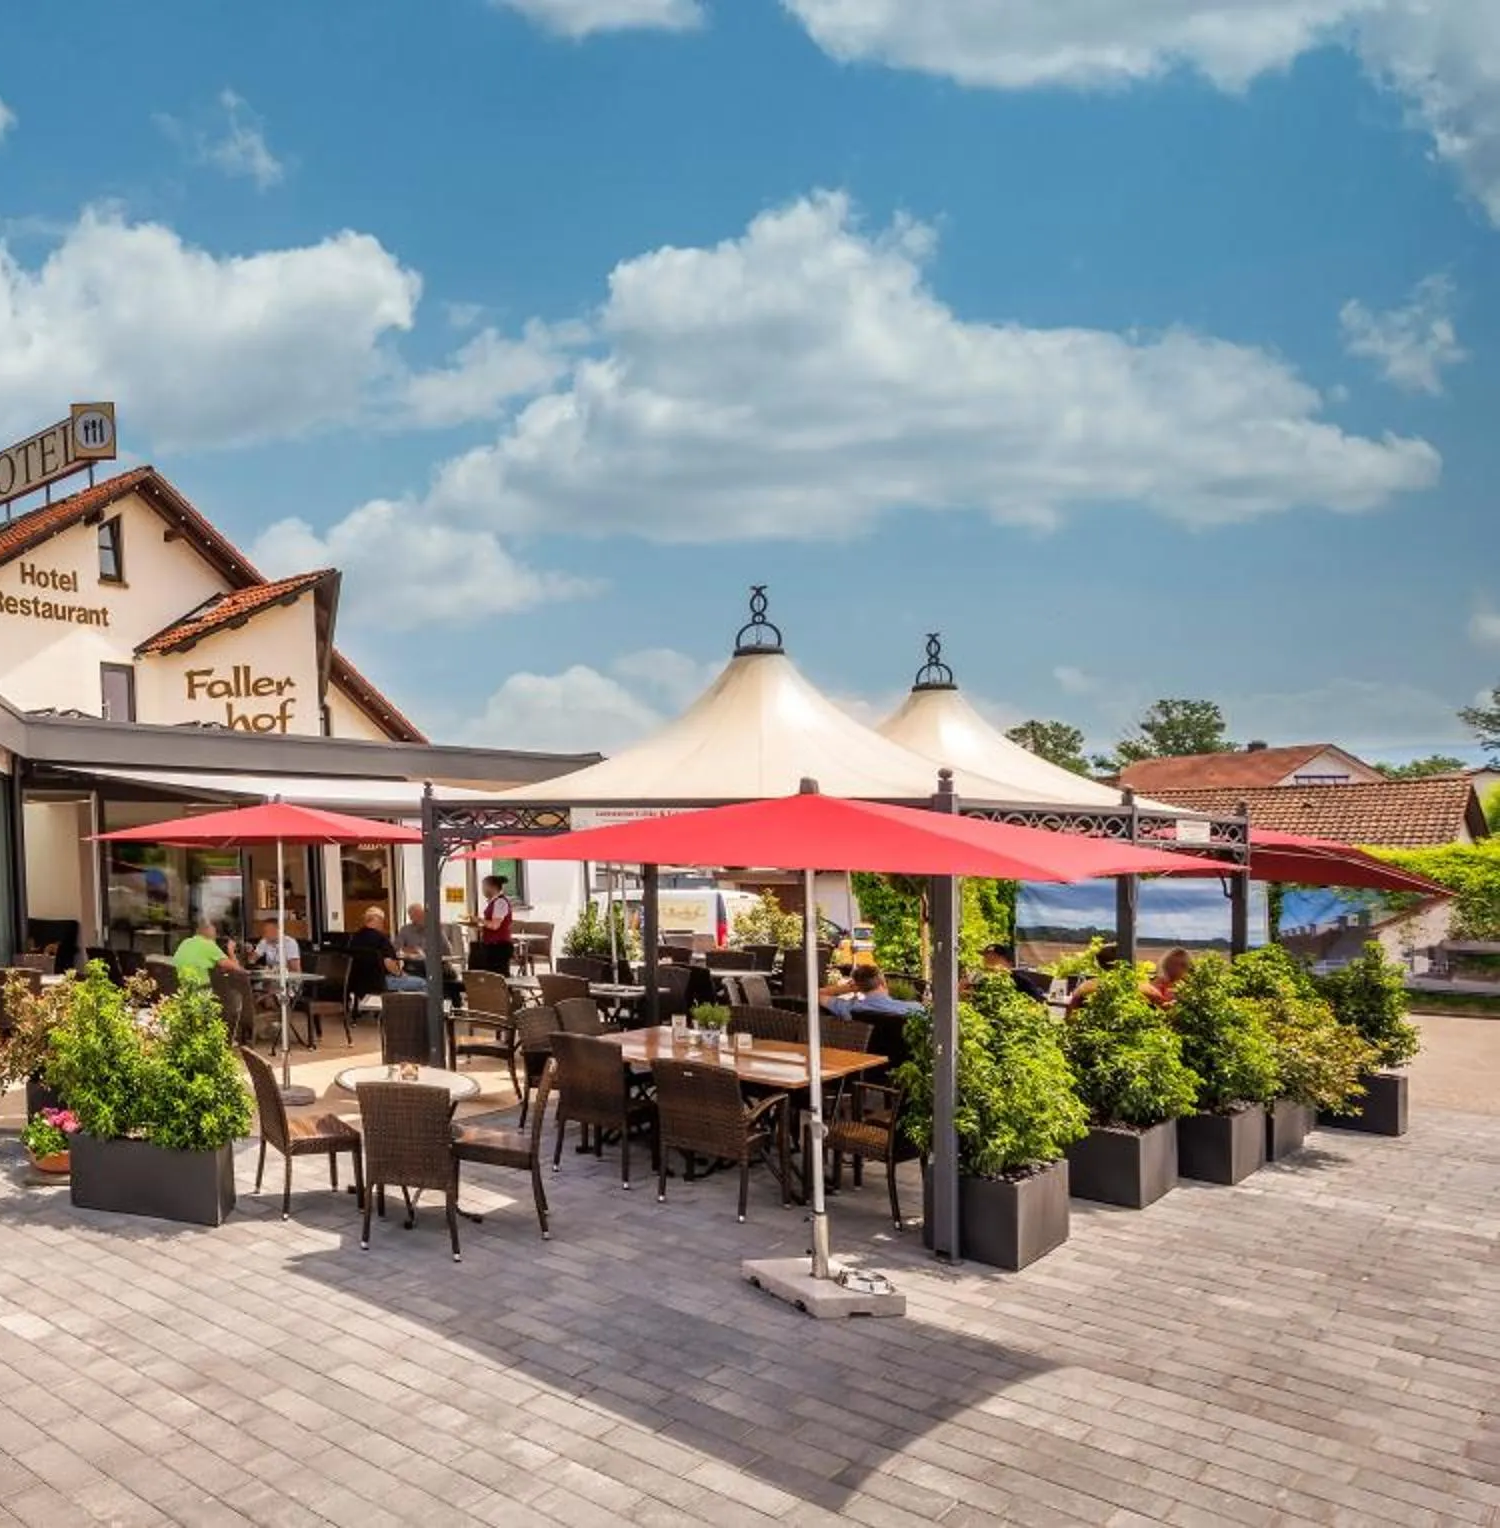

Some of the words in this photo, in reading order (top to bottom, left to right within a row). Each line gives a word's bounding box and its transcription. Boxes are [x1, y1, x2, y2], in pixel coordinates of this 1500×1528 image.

[20, 562, 78, 593] Hotel
[184, 665, 296, 701] Faller
[226, 697, 297, 734] hof
